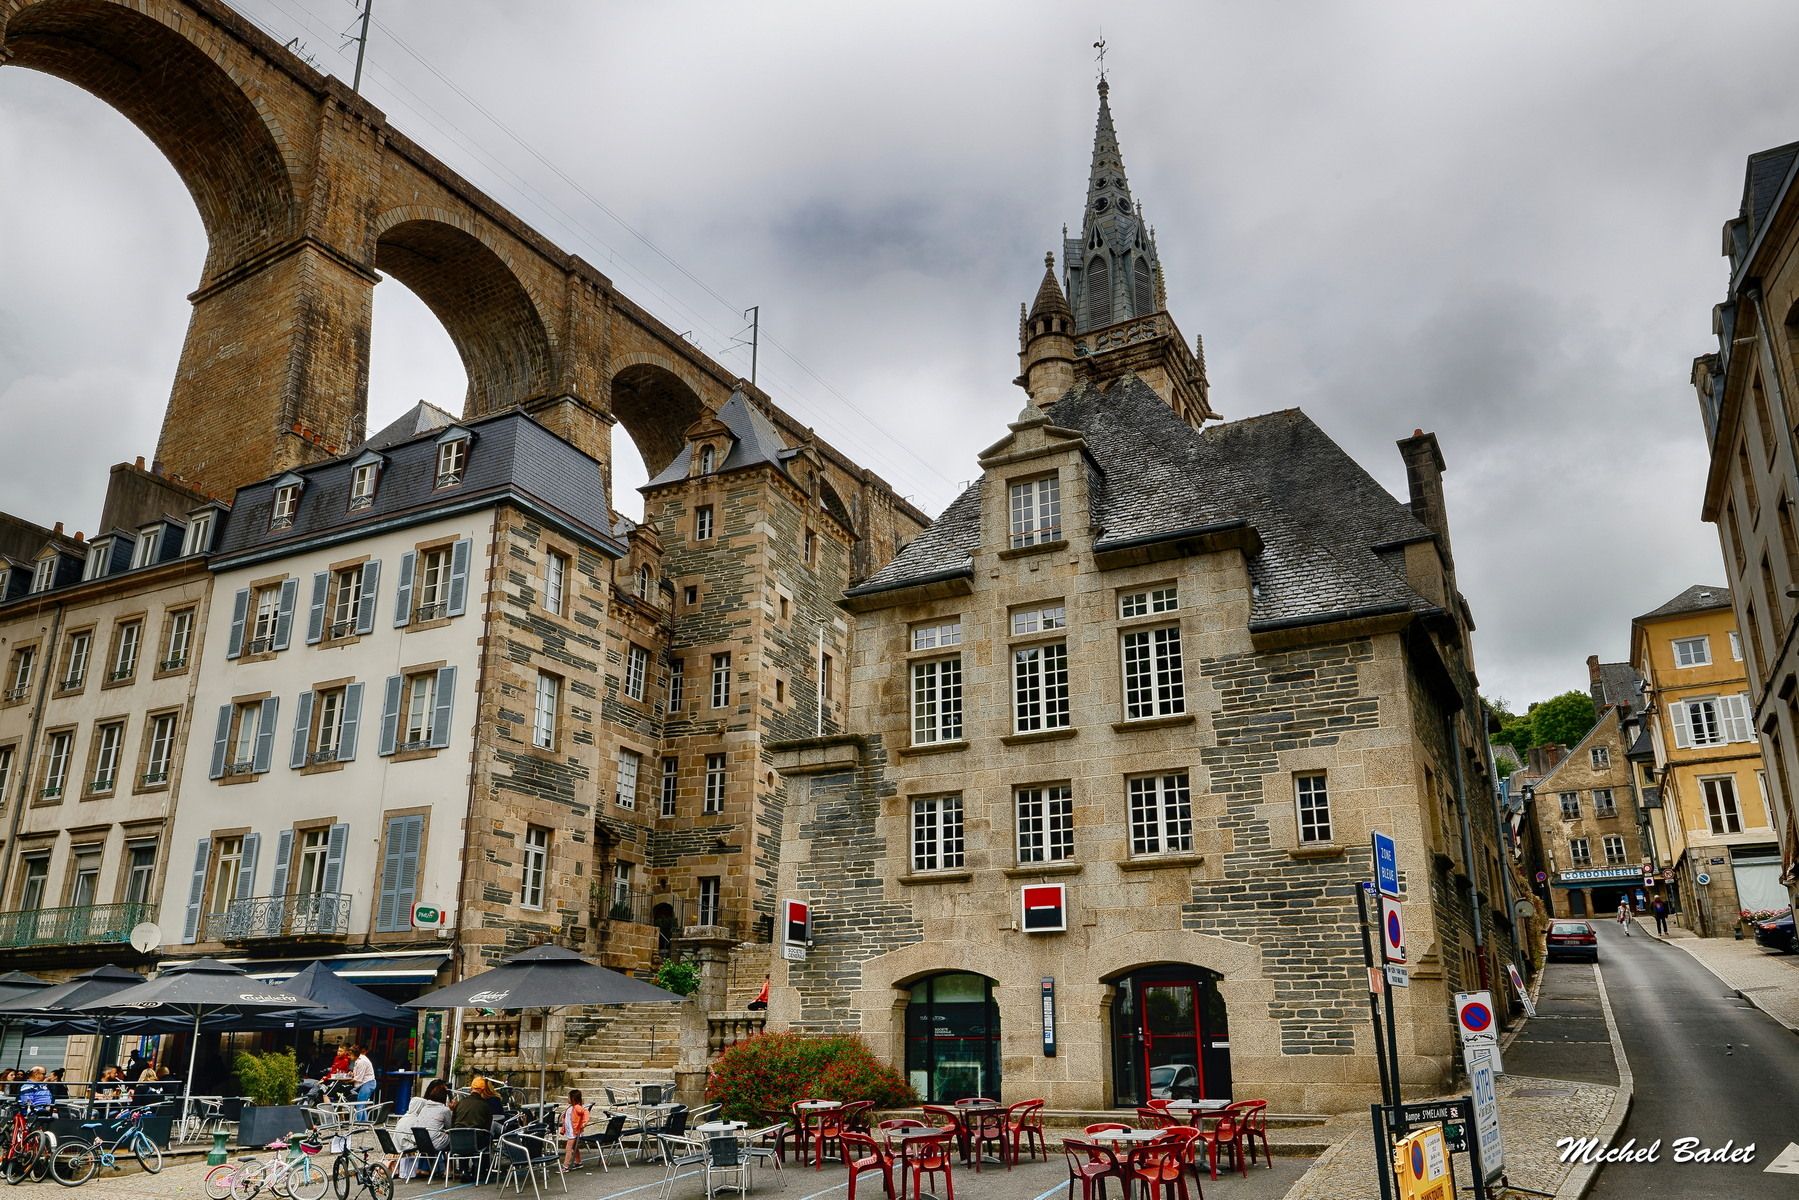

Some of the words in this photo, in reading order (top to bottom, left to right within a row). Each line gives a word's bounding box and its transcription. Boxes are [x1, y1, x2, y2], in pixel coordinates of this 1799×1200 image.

[1381, 847, 1392, 861] ZONE
[1381, 866, 1395, 881] BLEUE
[1564, 868, 1639, 880] CORDONNERIE
[239, 993, 297, 1003] Carlsberg
[1475, 1067, 1494, 1107] HOTEL
[1405, 1106, 1421, 1122] Rampe
